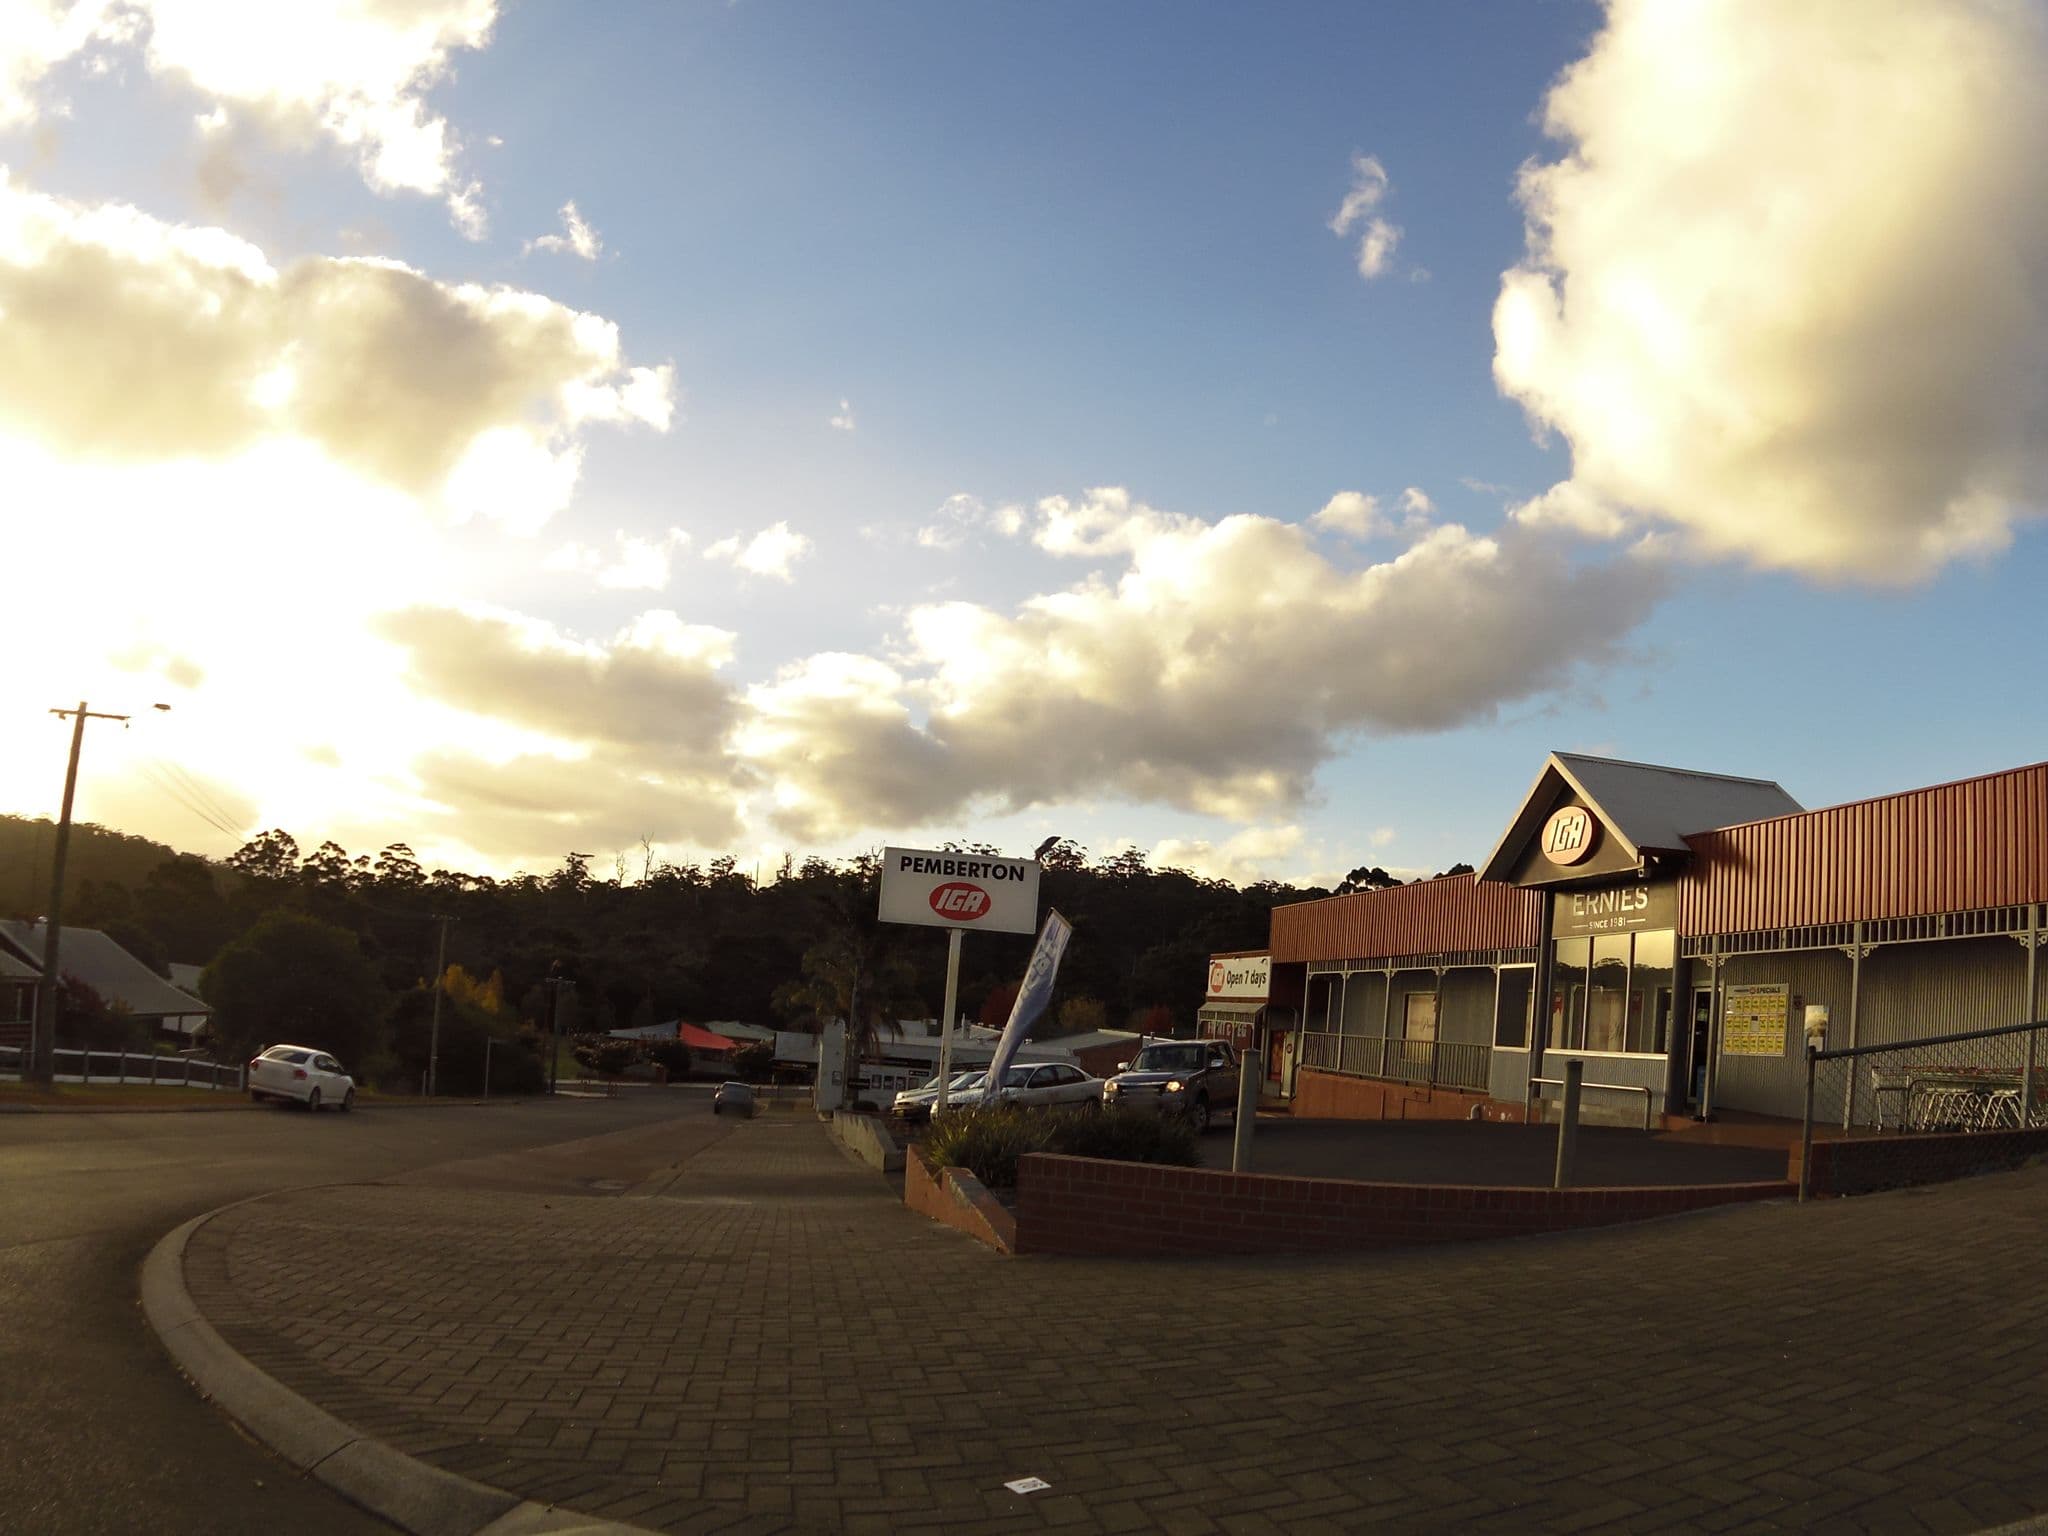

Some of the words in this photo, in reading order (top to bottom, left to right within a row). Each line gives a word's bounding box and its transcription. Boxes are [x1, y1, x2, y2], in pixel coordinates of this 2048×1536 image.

[1547, 814, 1587, 854] IGA
[901, 856, 1024, 881] PEMBERTON
[935, 888, 986, 913] IGA
[1588, 919, 1608, 929] SINCE
[1610, 917, 1626, 927] 1981
[1227, 971, 1243, 988] Open
[1244, 970, 1249, 985] 7
[1250, 970, 1266, 988] days
